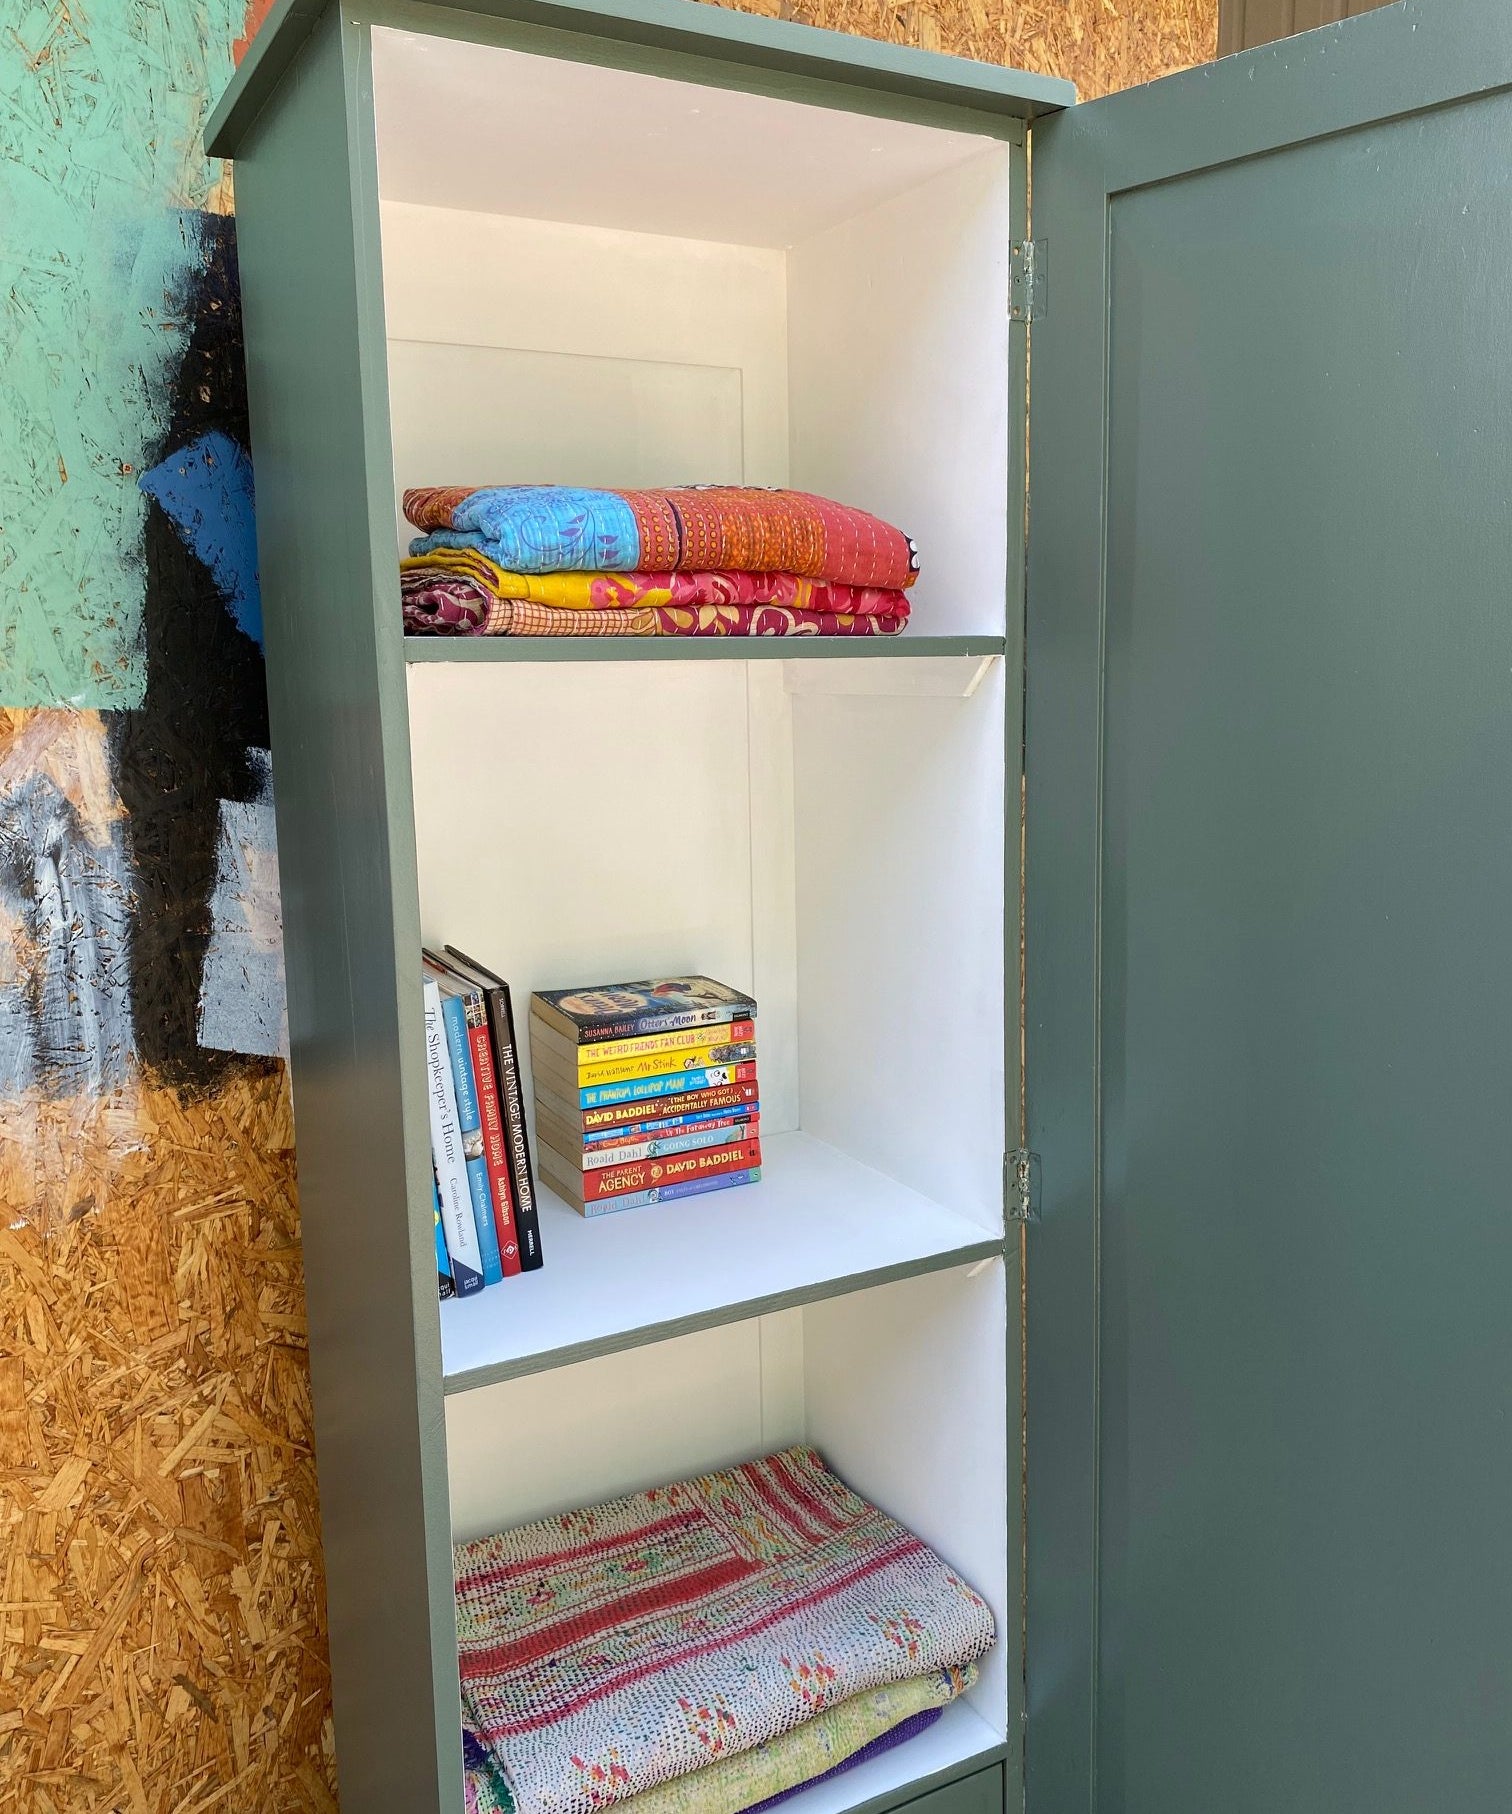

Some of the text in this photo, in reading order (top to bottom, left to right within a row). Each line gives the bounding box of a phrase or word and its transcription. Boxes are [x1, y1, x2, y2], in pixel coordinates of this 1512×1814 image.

[584, 1023, 635, 1038] SUSANNA BAILEY
[670, 1014, 697, 1026] Moon
[585, 1049, 600, 1058] THE
[630, 1039, 659, 1052] FRIENDS
[660, 1036, 675, 1047] FAN
[676, 1033, 695, 1045] CLUB
[451, 1015, 475, 1121] modern vintage style
[637, 1056, 678, 1072] Mr Stink
[425, 1007, 456, 1164] The Shopkeeper's Home
[585, 1092, 597, 1104] THE
[600, 1086, 632, 1102] PHANTOM
[633, 1080, 664, 1096] LOLLIPOP
[686, 1093, 699, 1101] BOY
[700, 1089, 717, 1099] WHO
[476, 1034, 504, 1167] CREATIVE FAMILY HOME
[662, 1099, 708, 1115] ACCIDENTALLY
[709, 1094, 741, 1107] FAMOUS
[585, 1104, 657, 1125] DAVID BADDIEL
[686, 1121, 716, 1134] Faraway
[717, 1118, 731, 1128] Tree
[501, 1043, 533, 1213] THE VINTAGE MODERN HOME
[663, 1135, 714, 1152] GOING SOLO
[586, 1147, 642, 1167] Roald Dahl
[666, 1149, 744, 1175] DAVID BADDIEL
[598, 1171, 647, 1194] AGENCY
[601, 1165, 643, 1180] THE PARENT
[475, 1171, 489, 1227] Emily Chalmers
[496, 1176, 511, 1226] Ashlyn Gibson
[590, 1192, 645, 1215] Roald Dahl
[449, 1177, 468, 1248] Caroline Rowland
[526, 1229, 536, 1257] MERRELL
